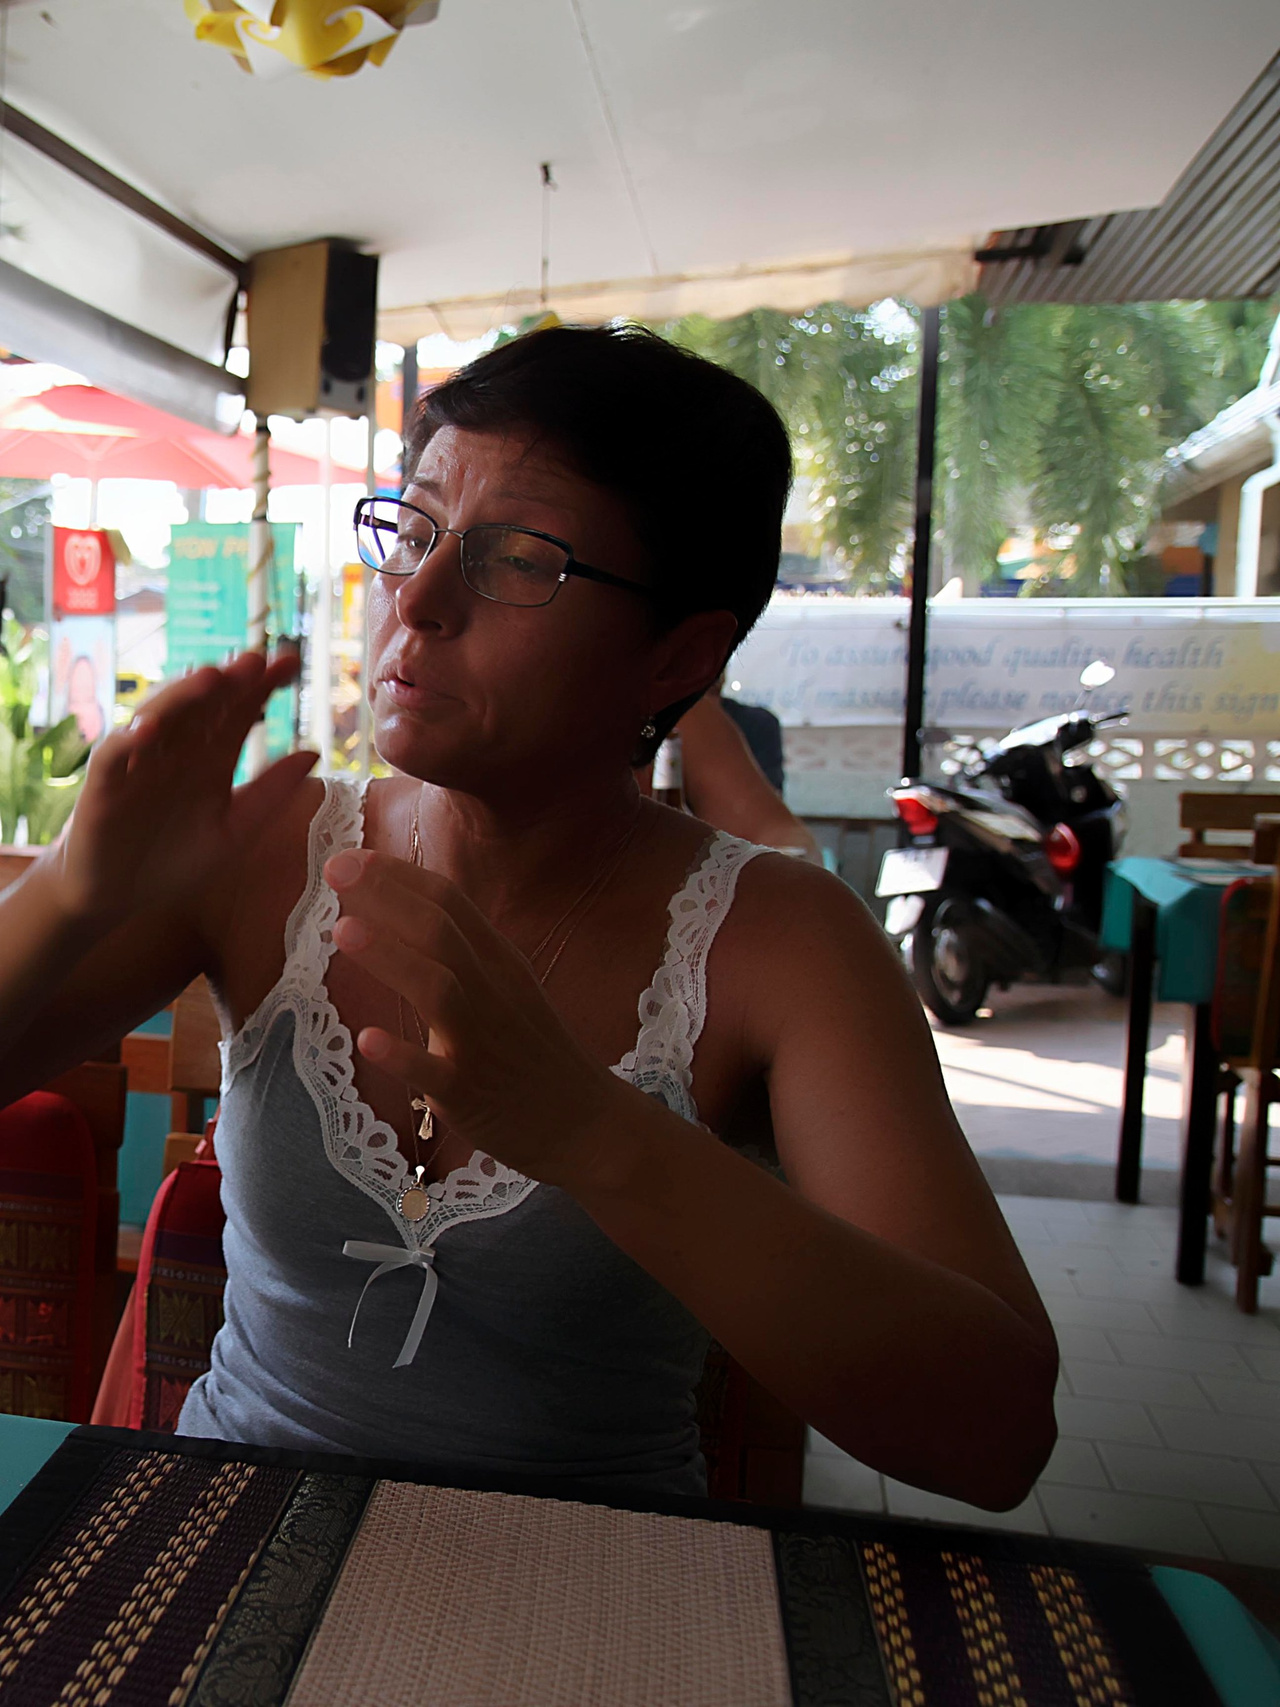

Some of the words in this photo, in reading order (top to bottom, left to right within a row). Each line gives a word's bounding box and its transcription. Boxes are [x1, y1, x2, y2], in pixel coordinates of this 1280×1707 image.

[778, 635, 819, 667] To
[1121, 634, 1226, 669] health
[1140, 680, 1207, 713] this
